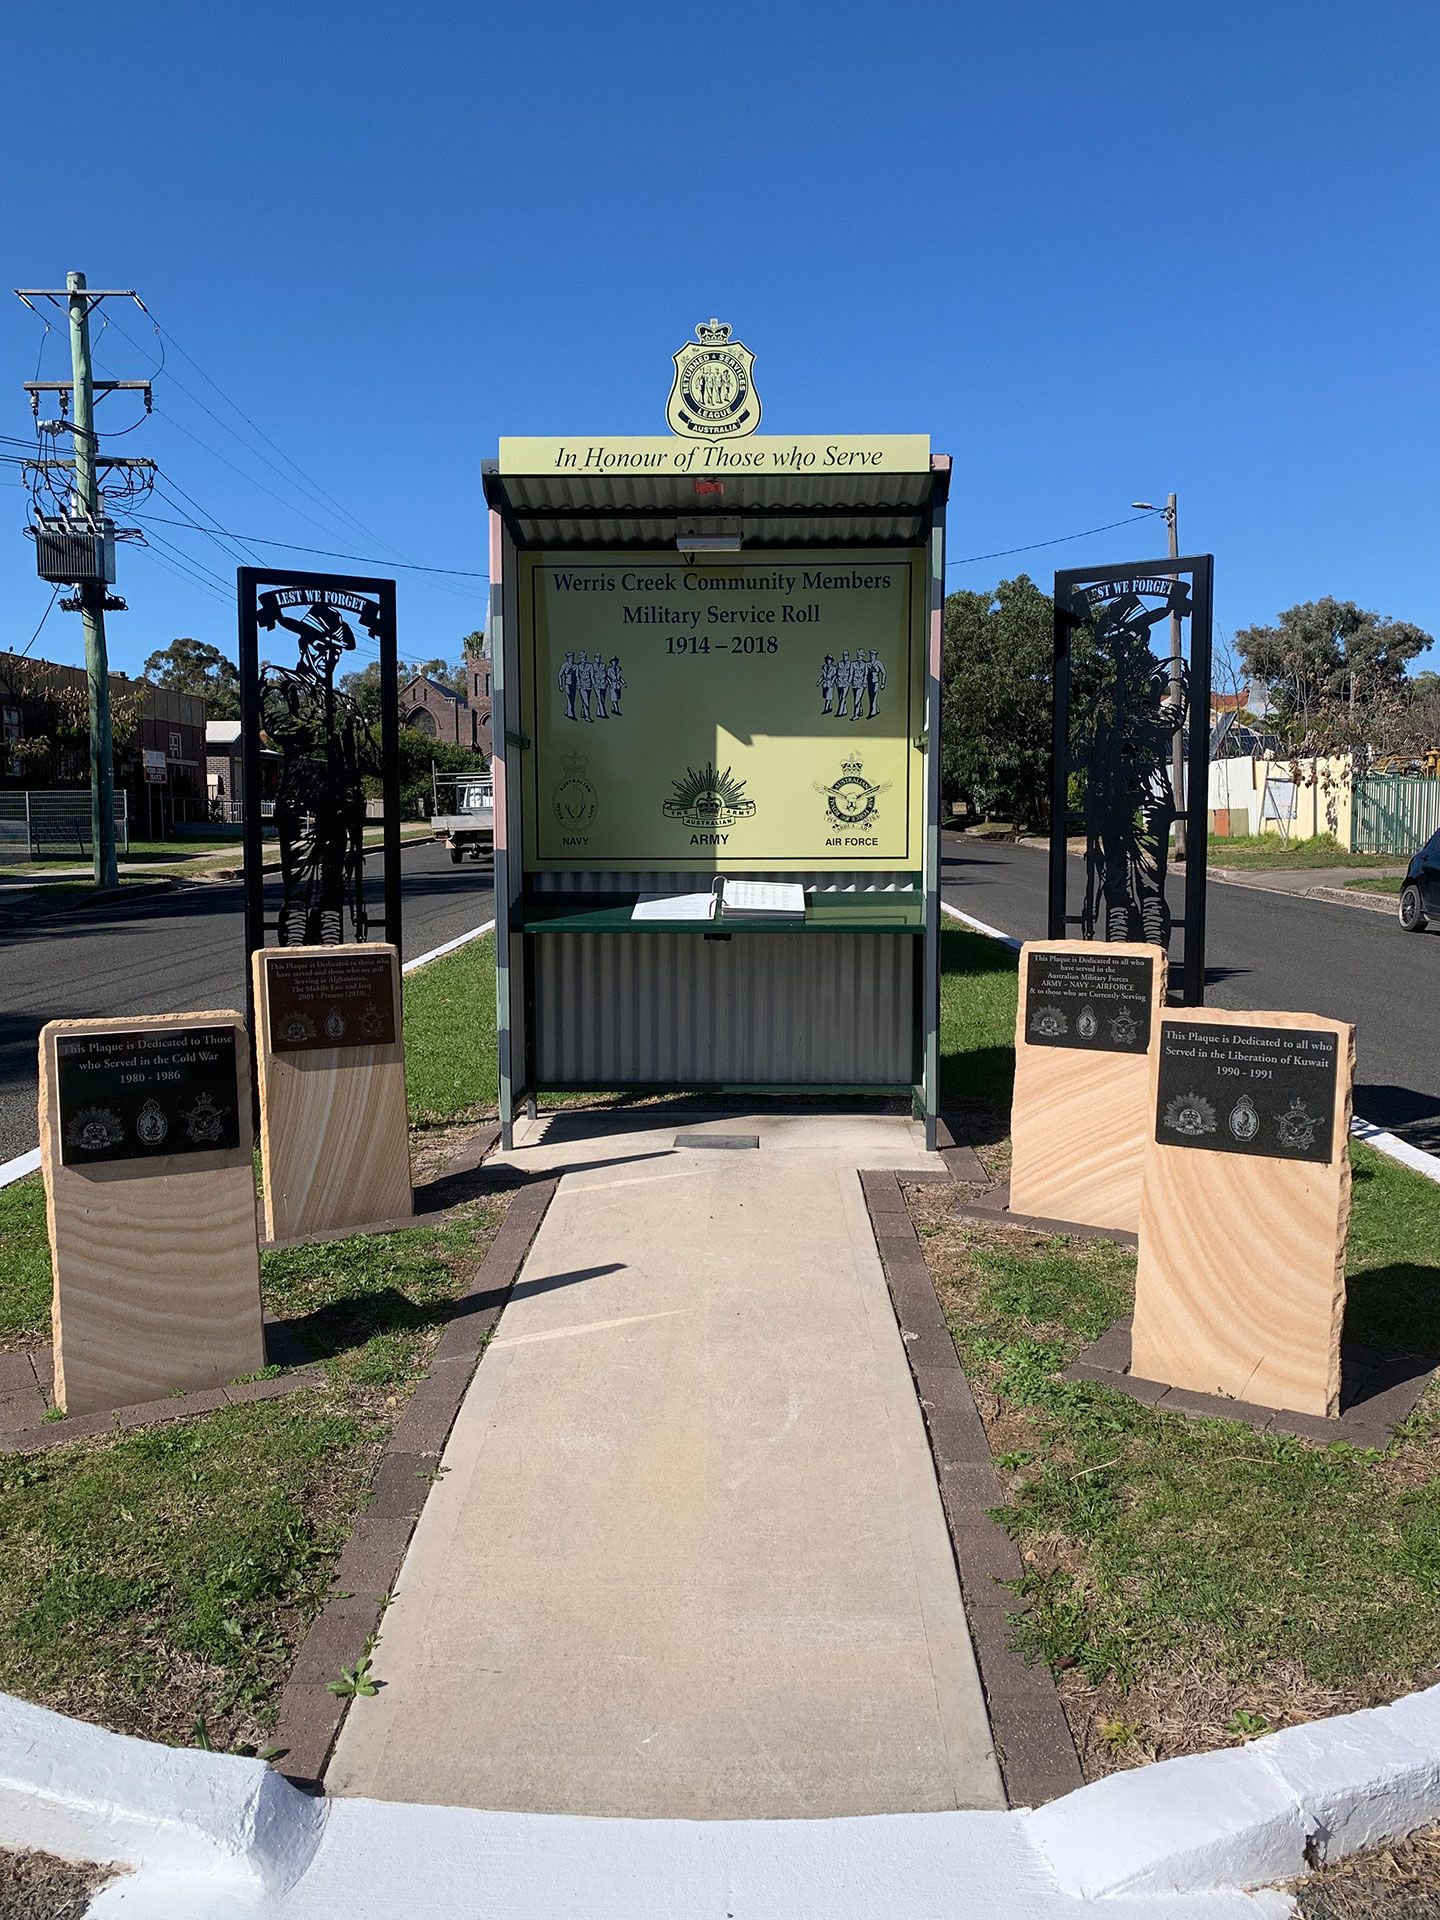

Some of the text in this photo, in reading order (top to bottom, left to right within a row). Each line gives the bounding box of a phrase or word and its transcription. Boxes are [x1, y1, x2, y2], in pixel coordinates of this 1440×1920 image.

[683, 354, 709, 394] RETURNED
[718, 354, 746, 391] SERVICES
[697, 407, 732, 418] LEAGUE
[692, 423, 738, 433] AUSTRALIA
[554, 445, 883, 472] In Honour of Those who Serve
[553, 571, 891, 595] Werris Creek Community Members
[1085, 579, 1175, 602] LEST WE FORGET
[275, 589, 367, 612] LEST WE FORGET
[622, 604, 820, 629] Military Service Roll
[665, 636, 710, 655] 1914
[731, 635, 778, 654] 2018
[686, 818, 732, 826] AUSTRALIAN
[562, 837, 589, 846] NAVY
[689, 834, 730, 845] ARMY
[825, 837, 879, 846] AIR FORCE
[1034, 954, 1048, 962] This
[1049, 955, 1070, 964] Plaque
[1079, 956, 1111, 965] Dedicated
[1060, 963, 1074, 971] have
[1047, 972, 1129, 982] Australian Military Forces
[1095, 982, 1135, 991] AIRFORCE
[1045, 988, 1062, 996] those
[1089, 990, 1120, 1001] Currently
[1120, 992, 1146, 1002] Serving
[64, 1034, 233, 1054] This Plaque is Dedicated to Those
[1165, 1030, 1333, 1051] This Plaque is Dedicated to all who
[78, 1051, 219, 1070] who Served in the Cold War
[1165, 1045, 1330, 1068] Served in the Liberation of Kuwait
[120, 1073, 145, 1084] 1980
[156, 1069, 181, 1081] 1986
[1217, 1066, 1240, 1077] 1990
[1249, 1069, 1273, 1079] 1991
